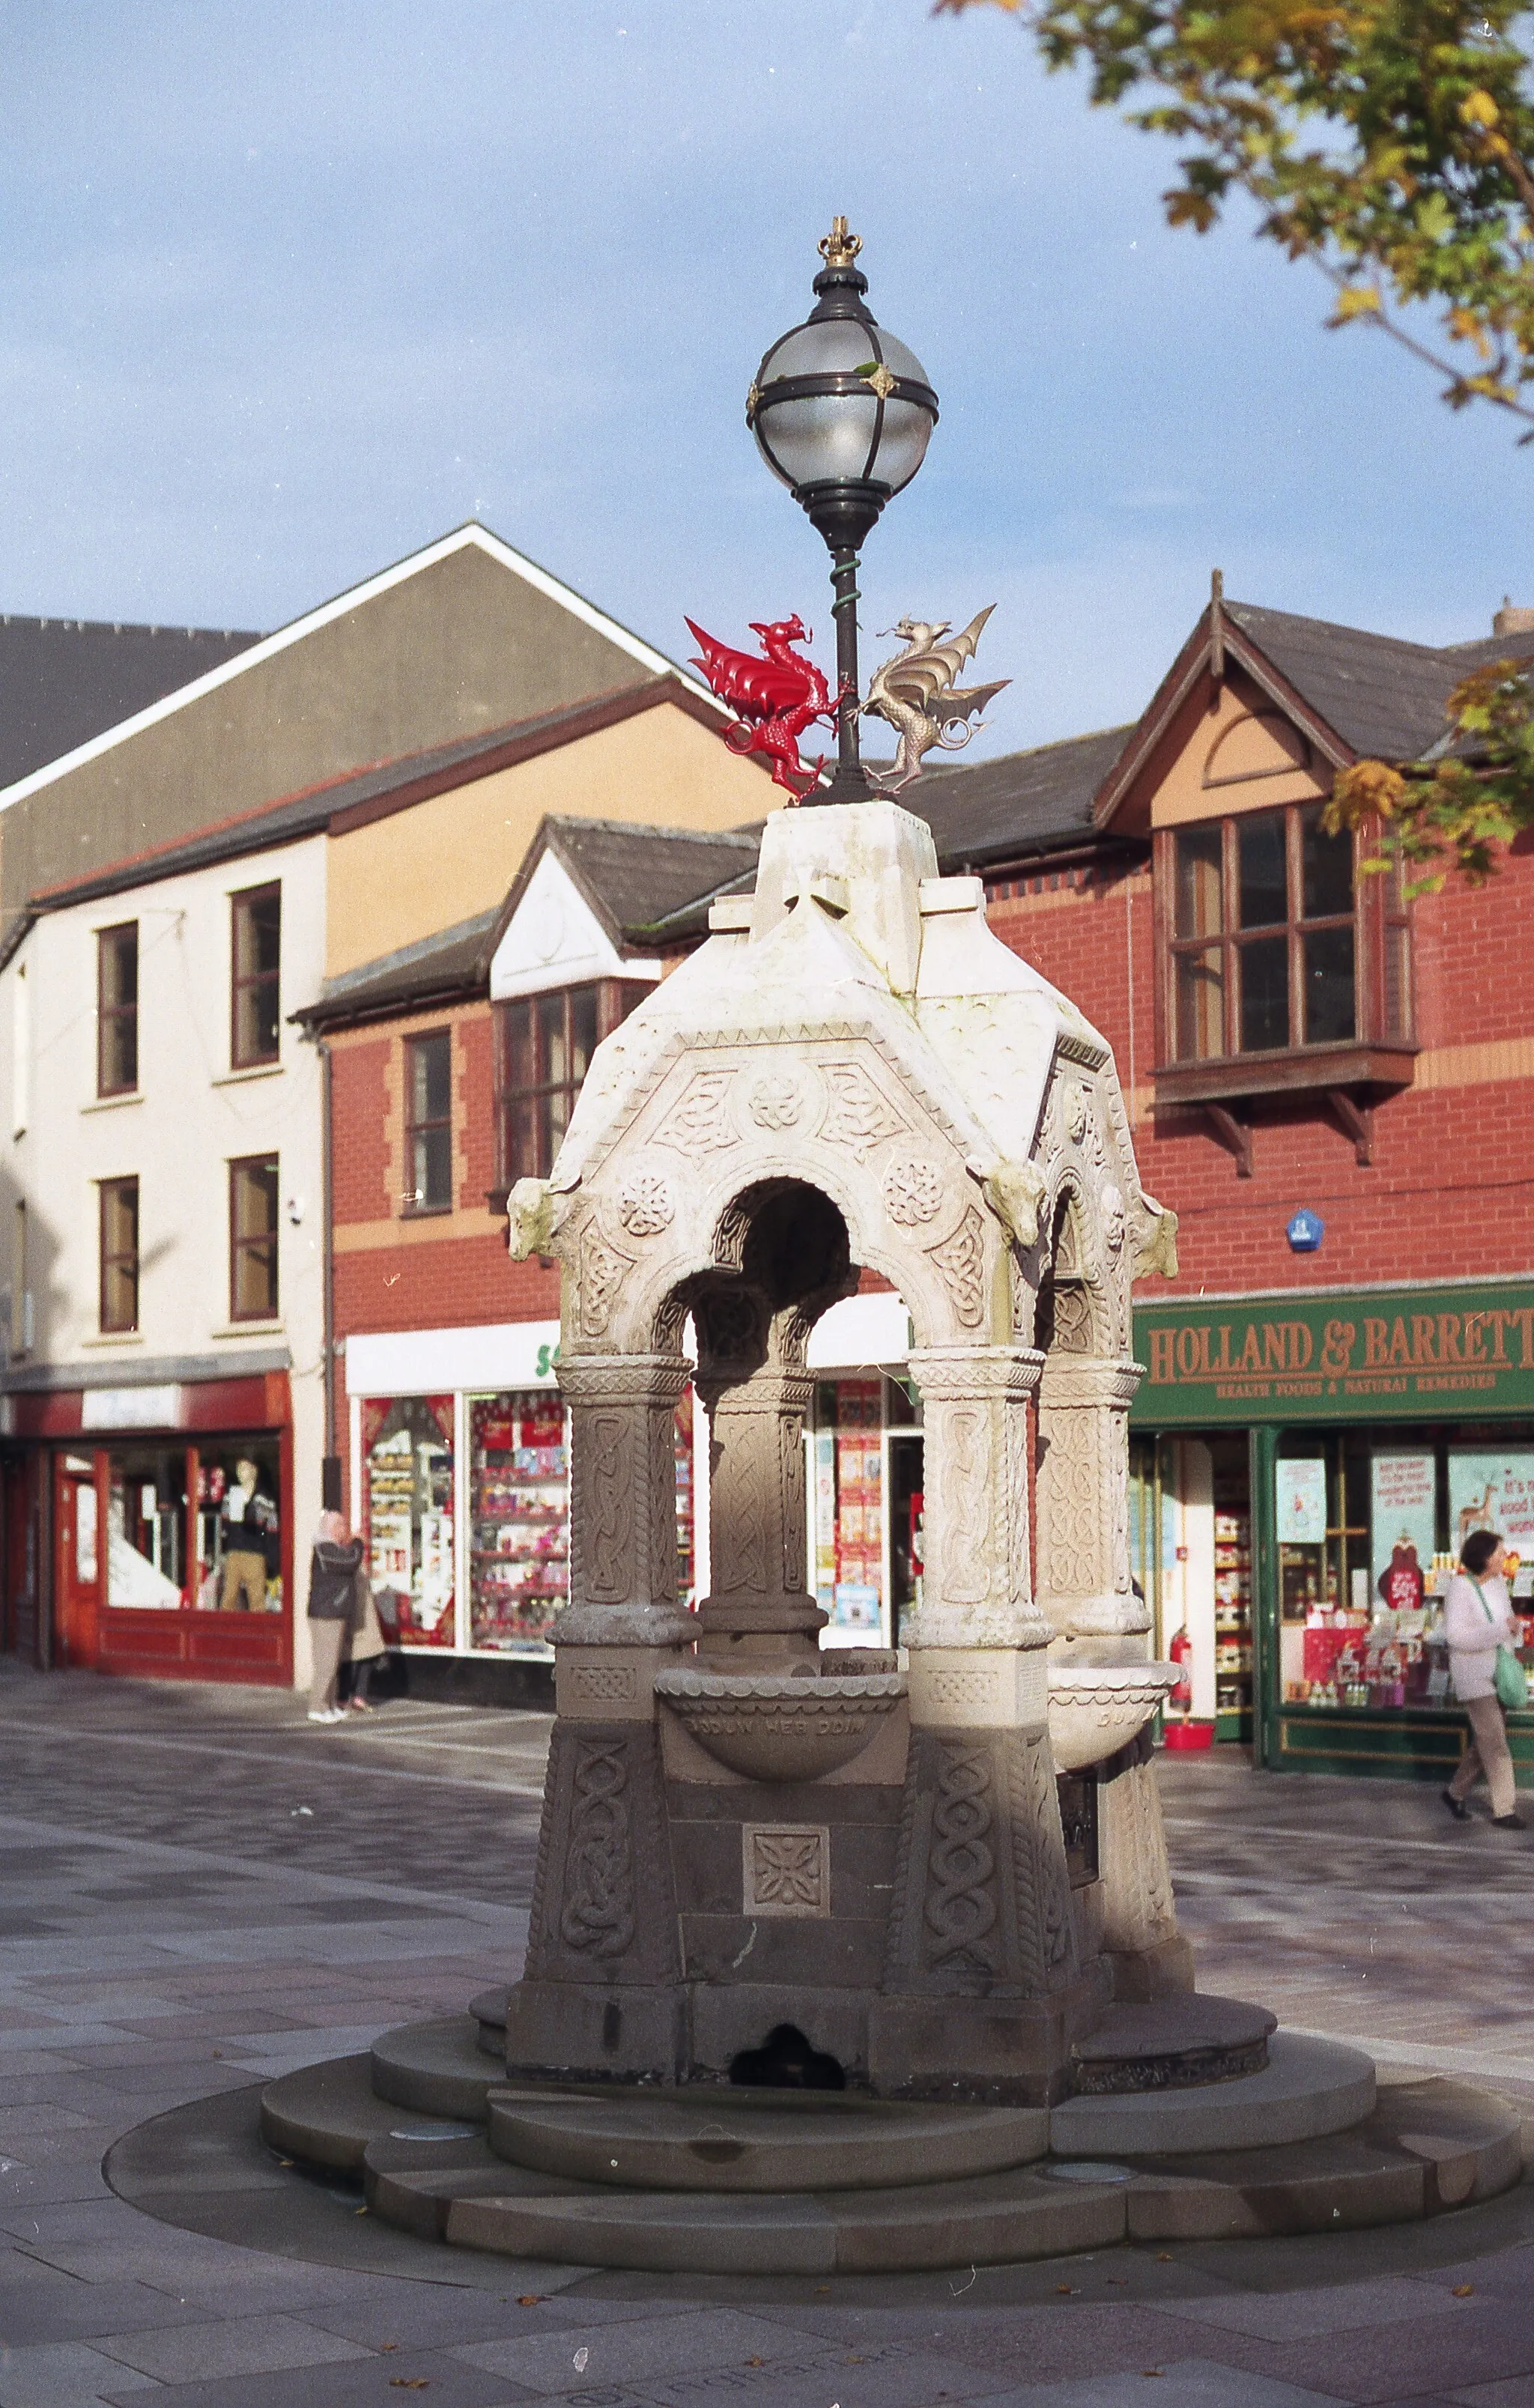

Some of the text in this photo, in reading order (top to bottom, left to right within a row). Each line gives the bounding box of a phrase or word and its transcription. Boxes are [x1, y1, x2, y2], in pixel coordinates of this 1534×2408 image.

[1148, 1308, 1534, 1384] HOLLAND & BARRETT
[1216, 1383, 1270, 1399] HEALTH
[1276, 1381, 1323, 1397] FOODS
[1344, 1377, 1407, 1395] NATURAL
[1416, 1374, 1497, 1392] REMEDIES
